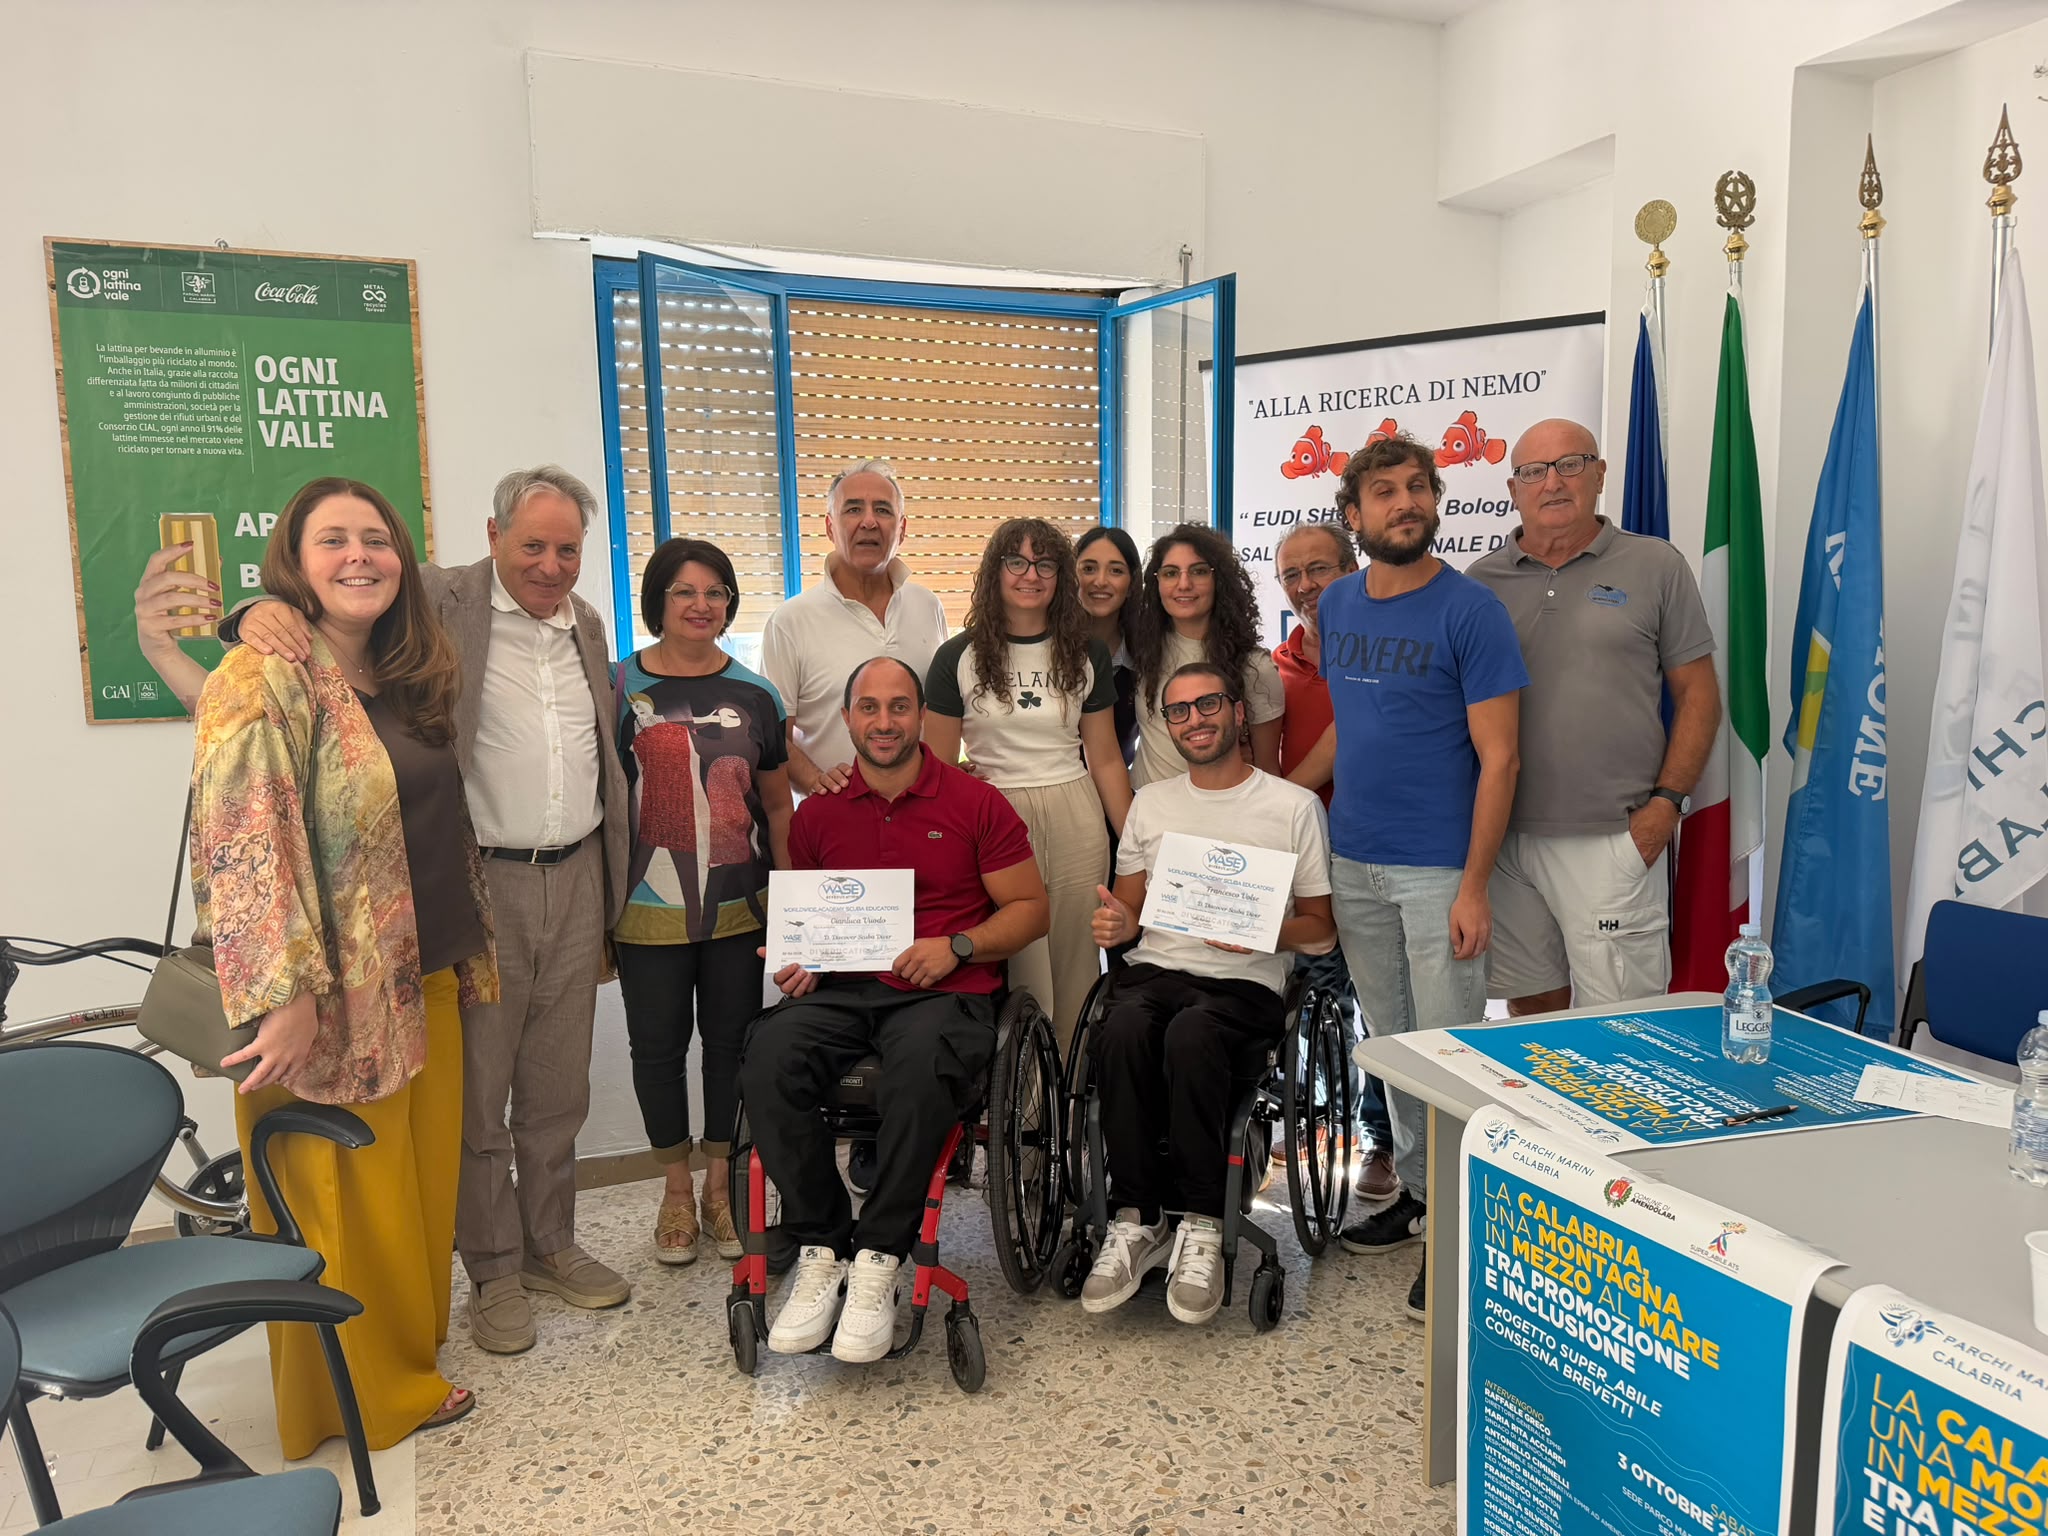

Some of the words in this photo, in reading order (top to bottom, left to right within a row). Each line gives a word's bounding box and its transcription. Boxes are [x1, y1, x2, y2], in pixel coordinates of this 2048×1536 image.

[103, 268, 129, 280] ogni
[103, 279, 142, 291] lattina
[104, 291, 130, 301] vale
[254, 281, 320, 305] Coca-Cola
[96, 343, 105, 352] La
[107, 344, 133, 353] lattina
[134, 345, 148, 355] per
[150, 345, 183, 355] bevande
[184, 346, 193, 355] in
[194, 346, 230, 357] alluminio
[231, 346, 237, 357] è
[99, 354, 151, 366] l'imballaggio
[152, 356, 165, 366] più
[166, 356, 197, 367] riciclato
[199, 358, 206, 367] al
[208, 359, 238, 368] mondo.
[87, 377, 137, 386] differenziata
[138, 378, 157, 387] fatta
[159, 379, 169, 388] da
[171, 380, 198, 389] milioni
[199, 380, 207, 389] di
[208, 381, 240, 390] cittadini
[107, 366, 132, 375] Anche
[133, 367, 142, 375] in
[143, 367, 166, 378] Italia,
[167, 368, 191, 379] grazie
[192, 370, 207, 378] alla
[208, 370, 239, 379] raccolta
[254, 355, 340, 386] OGNI
[115, 389, 124, 397] al
[125, 390, 150, 398] lavoro
[151, 391, 192, 400] congiunto
[192, 390, 201, 399] di
[202, 391, 240, 401] pubbliche
[123, 401, 189, 411] amministrazioni,
[190, 402, 218, 411] società
[219, 404, 232, 413] per
[233, 403, 241, 412] la
[256, 387, 390, 419] LATTINA
[1318, 383, 1421, 413] RICERCA
[1428, 379, 1455, 402] DI
[98, 422, 138, 431] Consorzio
[139, 423, 160, 433] CIAL,
[161, 424, 179, 434] ogni
[180, 425, 200, 433] anno
[201, 424, 206, 433] il
[207, 425, 223, 433] 91%
[224, 425, 243, 434] delle
[123, 412, 158, 422] gestione
[159, 413, 172, 421] dei
[173, 413, 195, 422] rifiuti
[196, 414, 222, 422] urbani
[229, 415, 242, 423] del
[112, 433, 138, 442] lattine
[139, 434, 175, 443] immesse
[176, 435, 188, 443] nel
[189, 436, 222, 444] mercato
[222, 437, 244, 445] viene
[118, 445, 150, 454] riciclato
[151, 447, 165, 456] per
[166, 446, 195, 455] tornare
[227, 447, 245, 456] vita.
[257, 420, 335, 449] VALE
[1253, 509, 1301, 527] EUDI
[1326, 631, 1435, 678] COVERI
[141, 683, 154, 691] AL
[1207, 853, 1242, 868] WASE
[822, 884, 859, 895] WASE
[1520, 1042, 1579, 1069] MARE
[1524, 1053, 1635, 1109] MONTAGNA
[1553, 1047, 1680, 1107] PROMOZIONE
[1605, 1063, 1729, 1118] INCLUSIONE
[1601, 1082, 1679, 1119] MEZZO
[1676, 1107, 1723, 1130] TRA
[1512, 1150, 1559, 1180] CALABRIA
[1518, 1136, 1554, 1161] PARCHI
[1556, 1153, 1594, 1179] MARINI
[1630, 1196, 1676, 1223] AMENDOLARA
[1633, 1190, 1664, 1210] COMUNE
[1483, 1173, 1511, 1207] LA
[1517, 1190, 1649, 1282] CALABRIA,
[1484, 1197, 1531, 1240] UNA
[1538, 1224, 1683, 1323] MONTAGNA
[1485, 1221, 1505, 1250] IN
[1512, 1235, 1591, 1298] MEZZO
[1597, 1282, 1630, 1321] AL
[1638, 1303, 1719, 1371] MARE
[1483, 1244, 1525, 1285] TRA
[1531, 1270, 1690, 1381] PROMOZIONE
[1484, 1266, 1497, 1292] E
[1502, 1277, 1636, 1375] INCLUSIONE
[1484, 1296, 1556, 1352] PROGETTO
[1559, 1342, 1661, 1419] SUPER_ABILE
[1484, 1314, 1559, 1372] CONSEGNA
[1562, 1362, 1633, 1420] BREVETTI
[1943, 1335, 2013, 1372] PARCHI
[1933, 1350, 2024, 1402] CALABRIA
[1484, 1378, 1544, 1423] INTERVENGONO
[1484, 1387, 1523, 1418] RAFFAELE
[1524, 1413, 1550, 1437] GRECO
[1872, 1373, 1923, 1426] LA
[1484, 1406, 1510, 1429] MARIA
[1510, 1423, 1528, 1441] RITA
[1529, 1436, 1566, 1468] ACCIARDI
[1869, 1405, 1957, 1479] UNA
[1484, 1424, 1531, 1461] ANTONELLO
[1531, 1456, 1569, 1490] CIMINELLI
[1484, 1443, 1521, 1473] VITTORIO
[1522, 1468, 1561, 1503] BIANCHINI
[1867, 1437, 1905, 1483] IN
[1484, 1461, 1531, 1499] FRANCESCO
[1532, 1494, 1559, 1521] MOTTA
[1484, 1480, 1522, 1512] MANUELA
[1617, 1451, 1627, 1472] 3
[1631, 1460, 1714, 1533] OTTOBRE
[1863, 1467, 1941, 1536] TRA
[1483, 1498, 1514, 1525] CHIARA
[1643, 1501, 1673, 1530] PARCO
[1863, 1497, 1886, 1535] E
